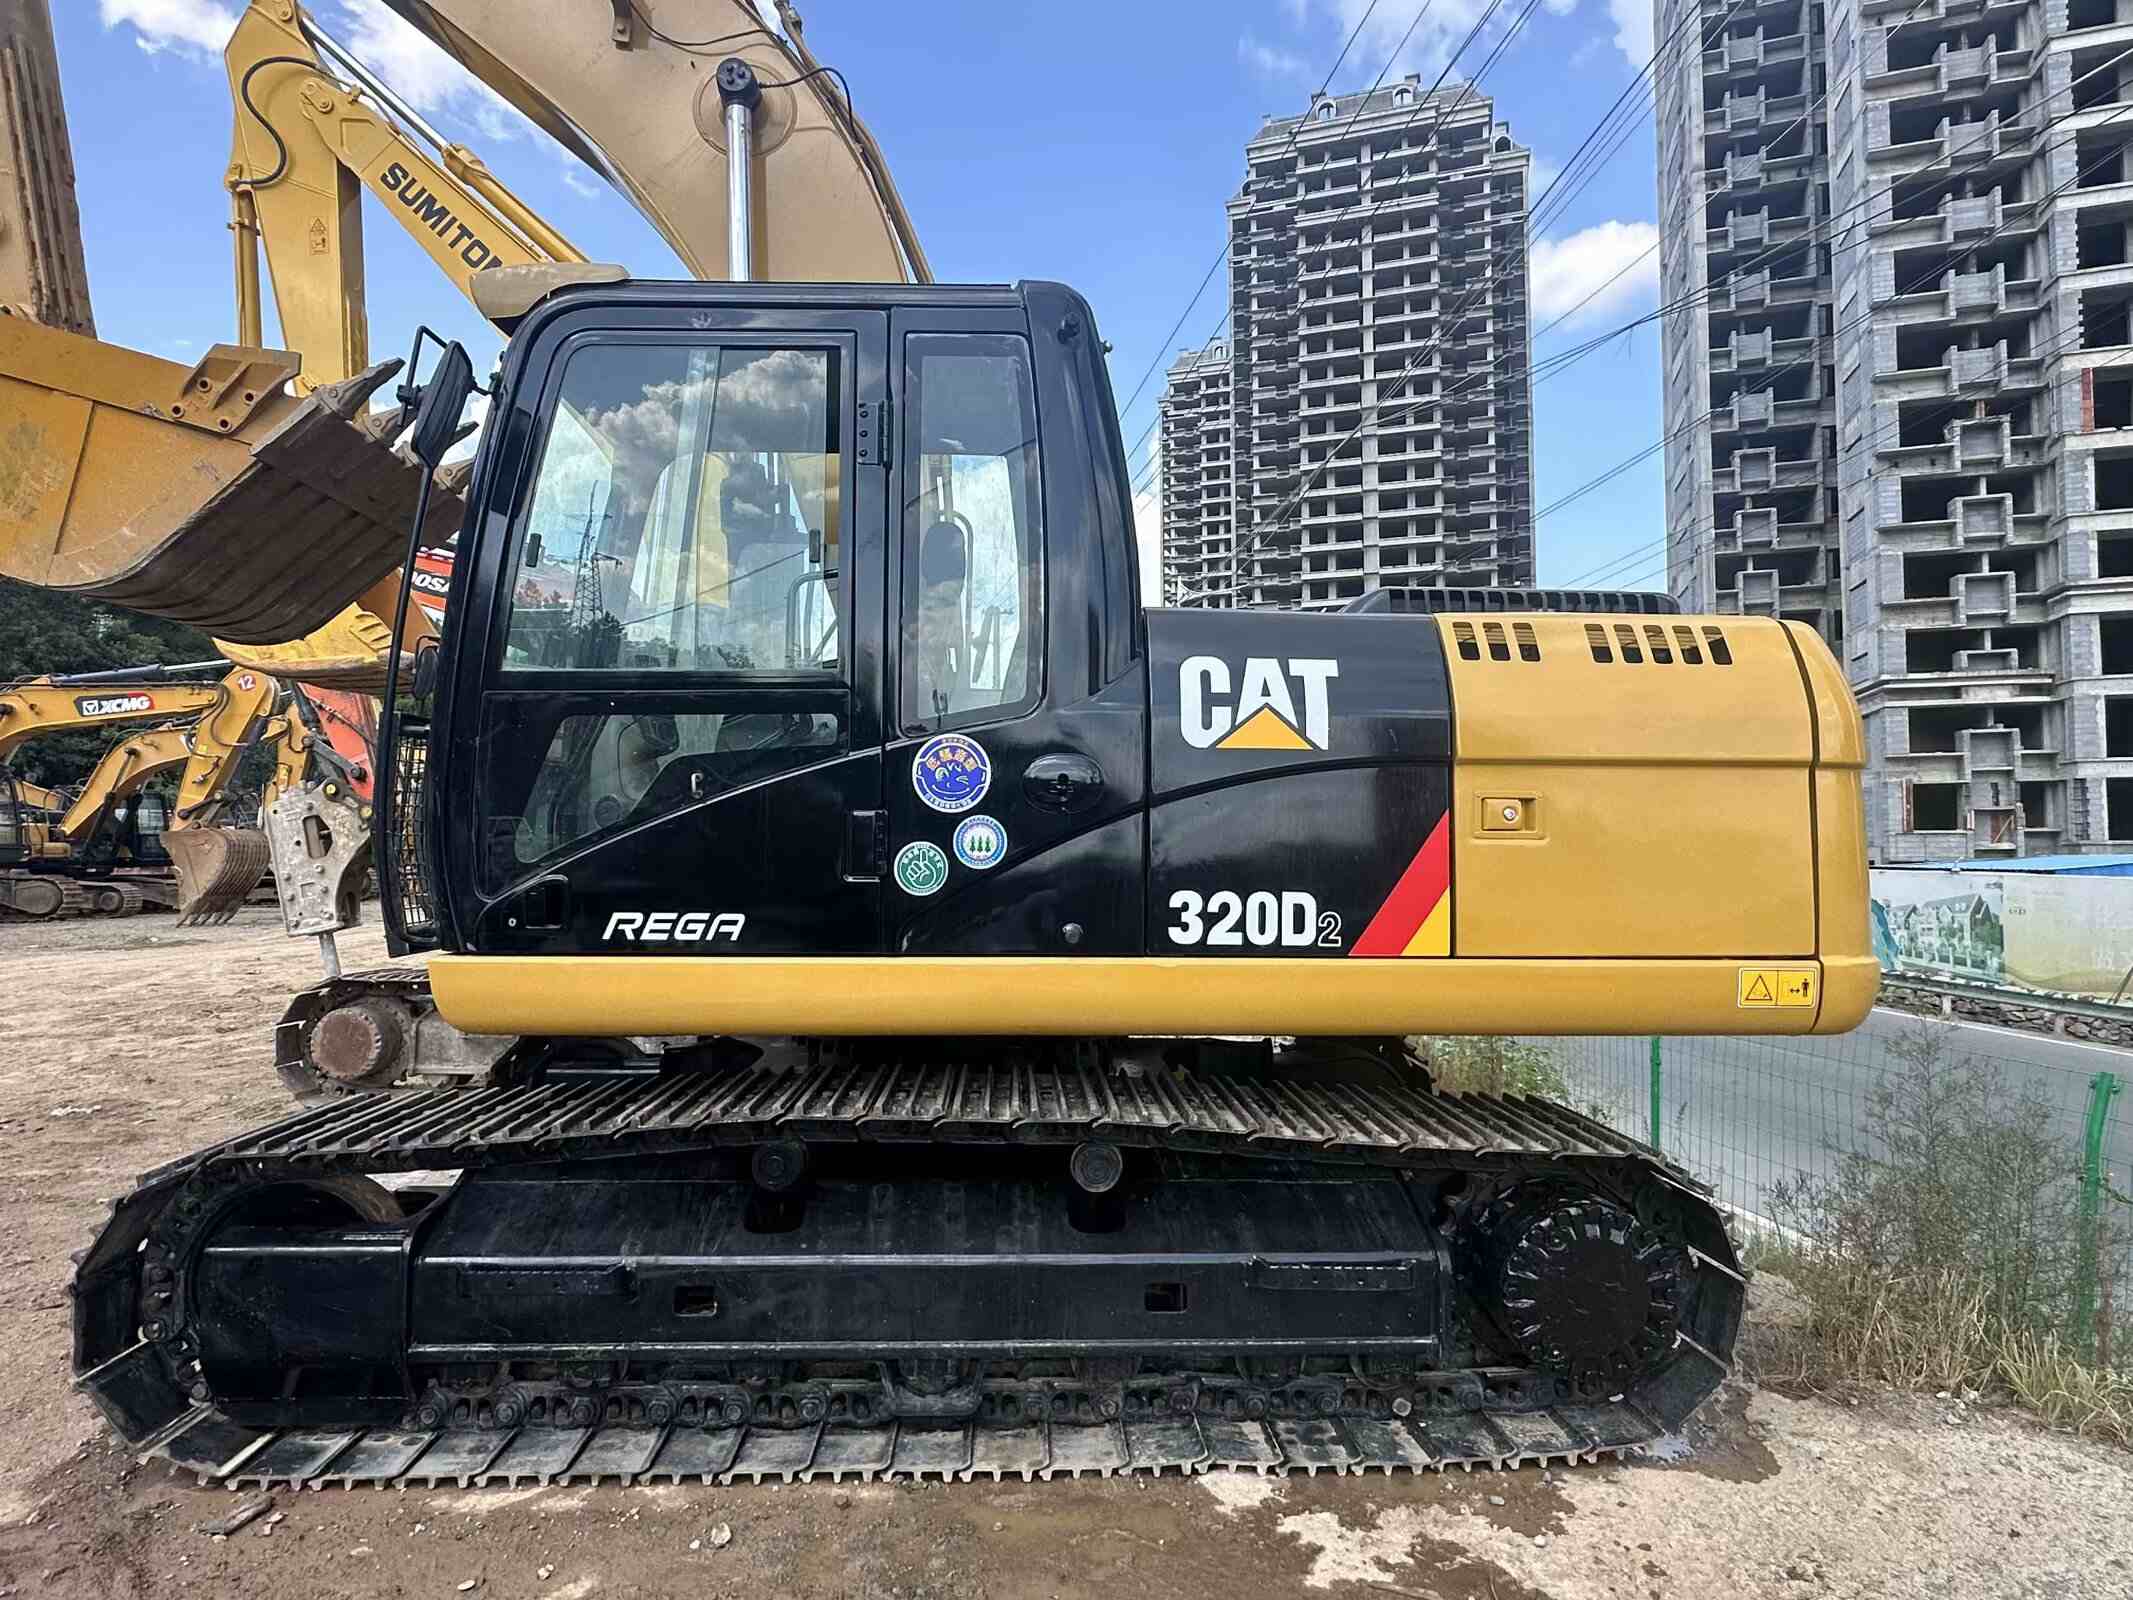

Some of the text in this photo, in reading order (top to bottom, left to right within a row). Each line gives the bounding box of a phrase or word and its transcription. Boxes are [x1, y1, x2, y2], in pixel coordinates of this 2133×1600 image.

[238, 674, 256, 691] 12
[100, 695, 150, 714] XCMG
[1179, 655, 1339, 750] CAT
[602, 911, 746, 941] REGA
